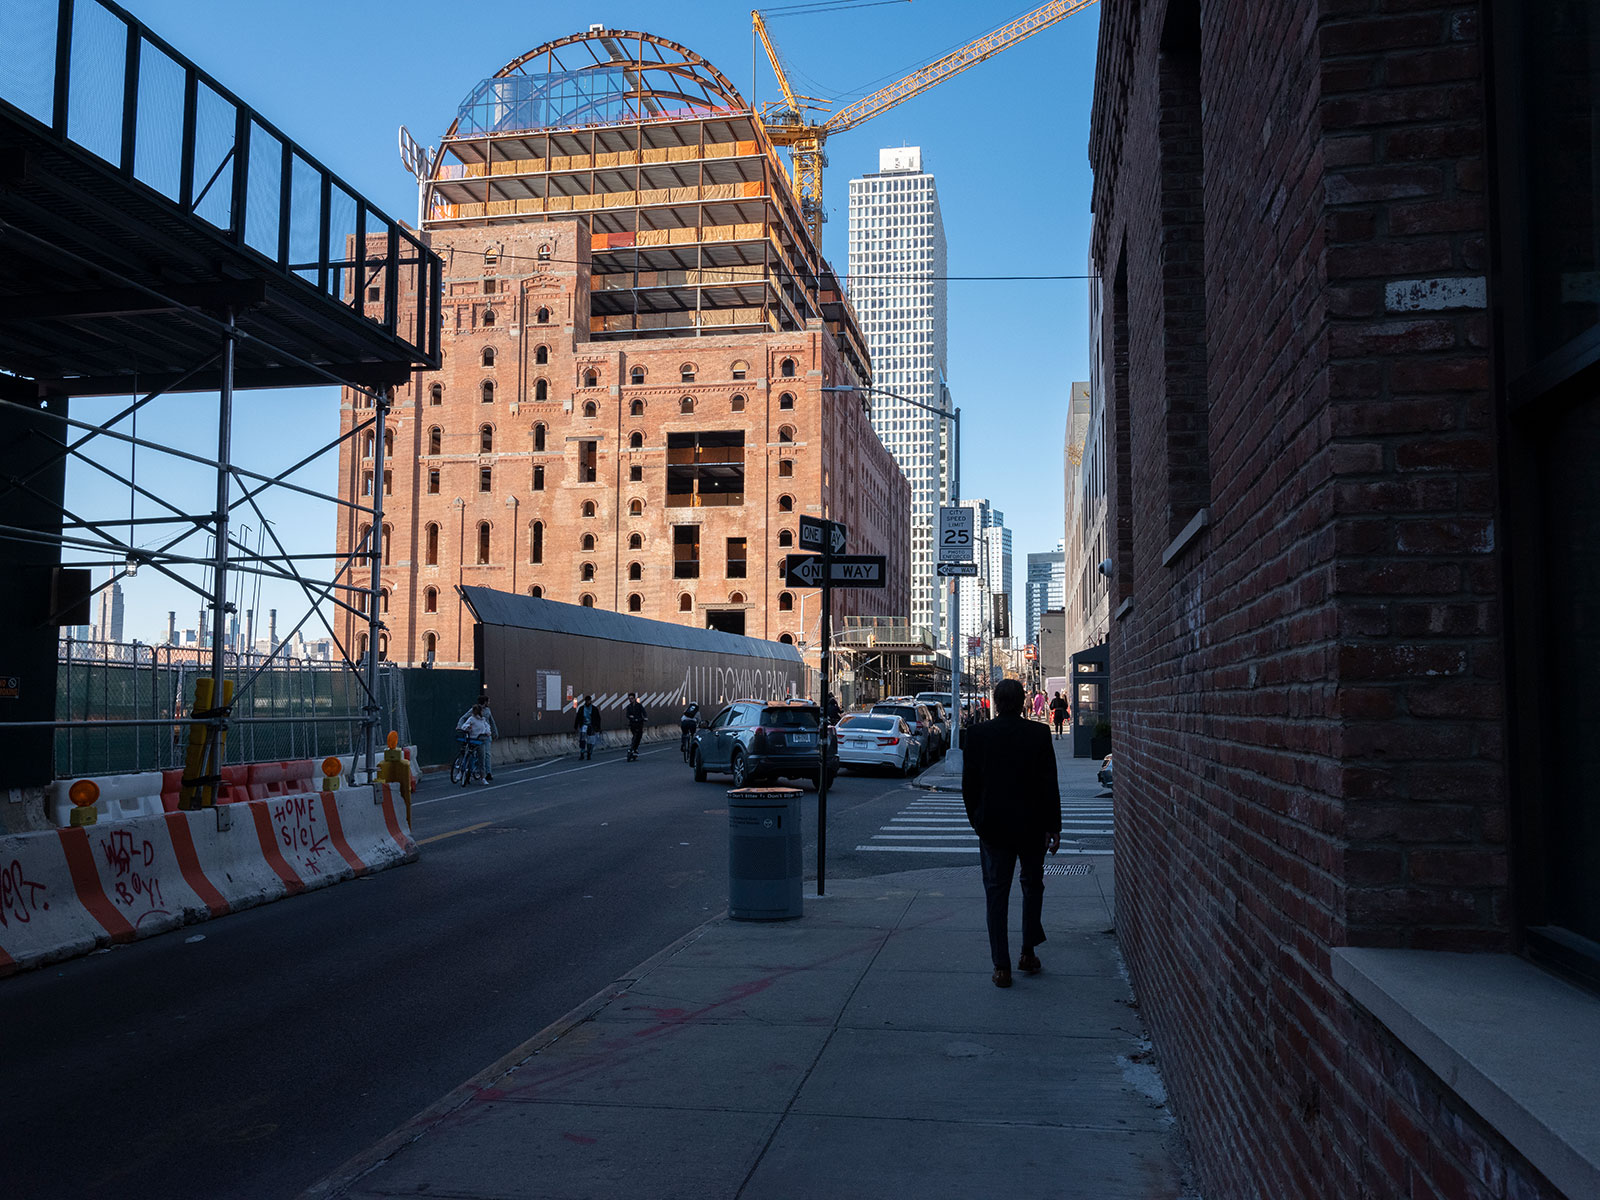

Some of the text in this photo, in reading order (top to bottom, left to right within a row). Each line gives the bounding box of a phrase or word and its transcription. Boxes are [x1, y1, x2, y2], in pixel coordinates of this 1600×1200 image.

[804, 526, 819, 541] ONE
[944, 529, 969, 544] 25
[801, 565, 873, 578] ON WAY
[715, 666, 788, 705] DOMINO PARK
[274, 798, 316, 829] HOME
[100, 829, 154, 867] WILD
[281, 824, 329, 857] SICK
[115, 872, 165, 908] BOY!
